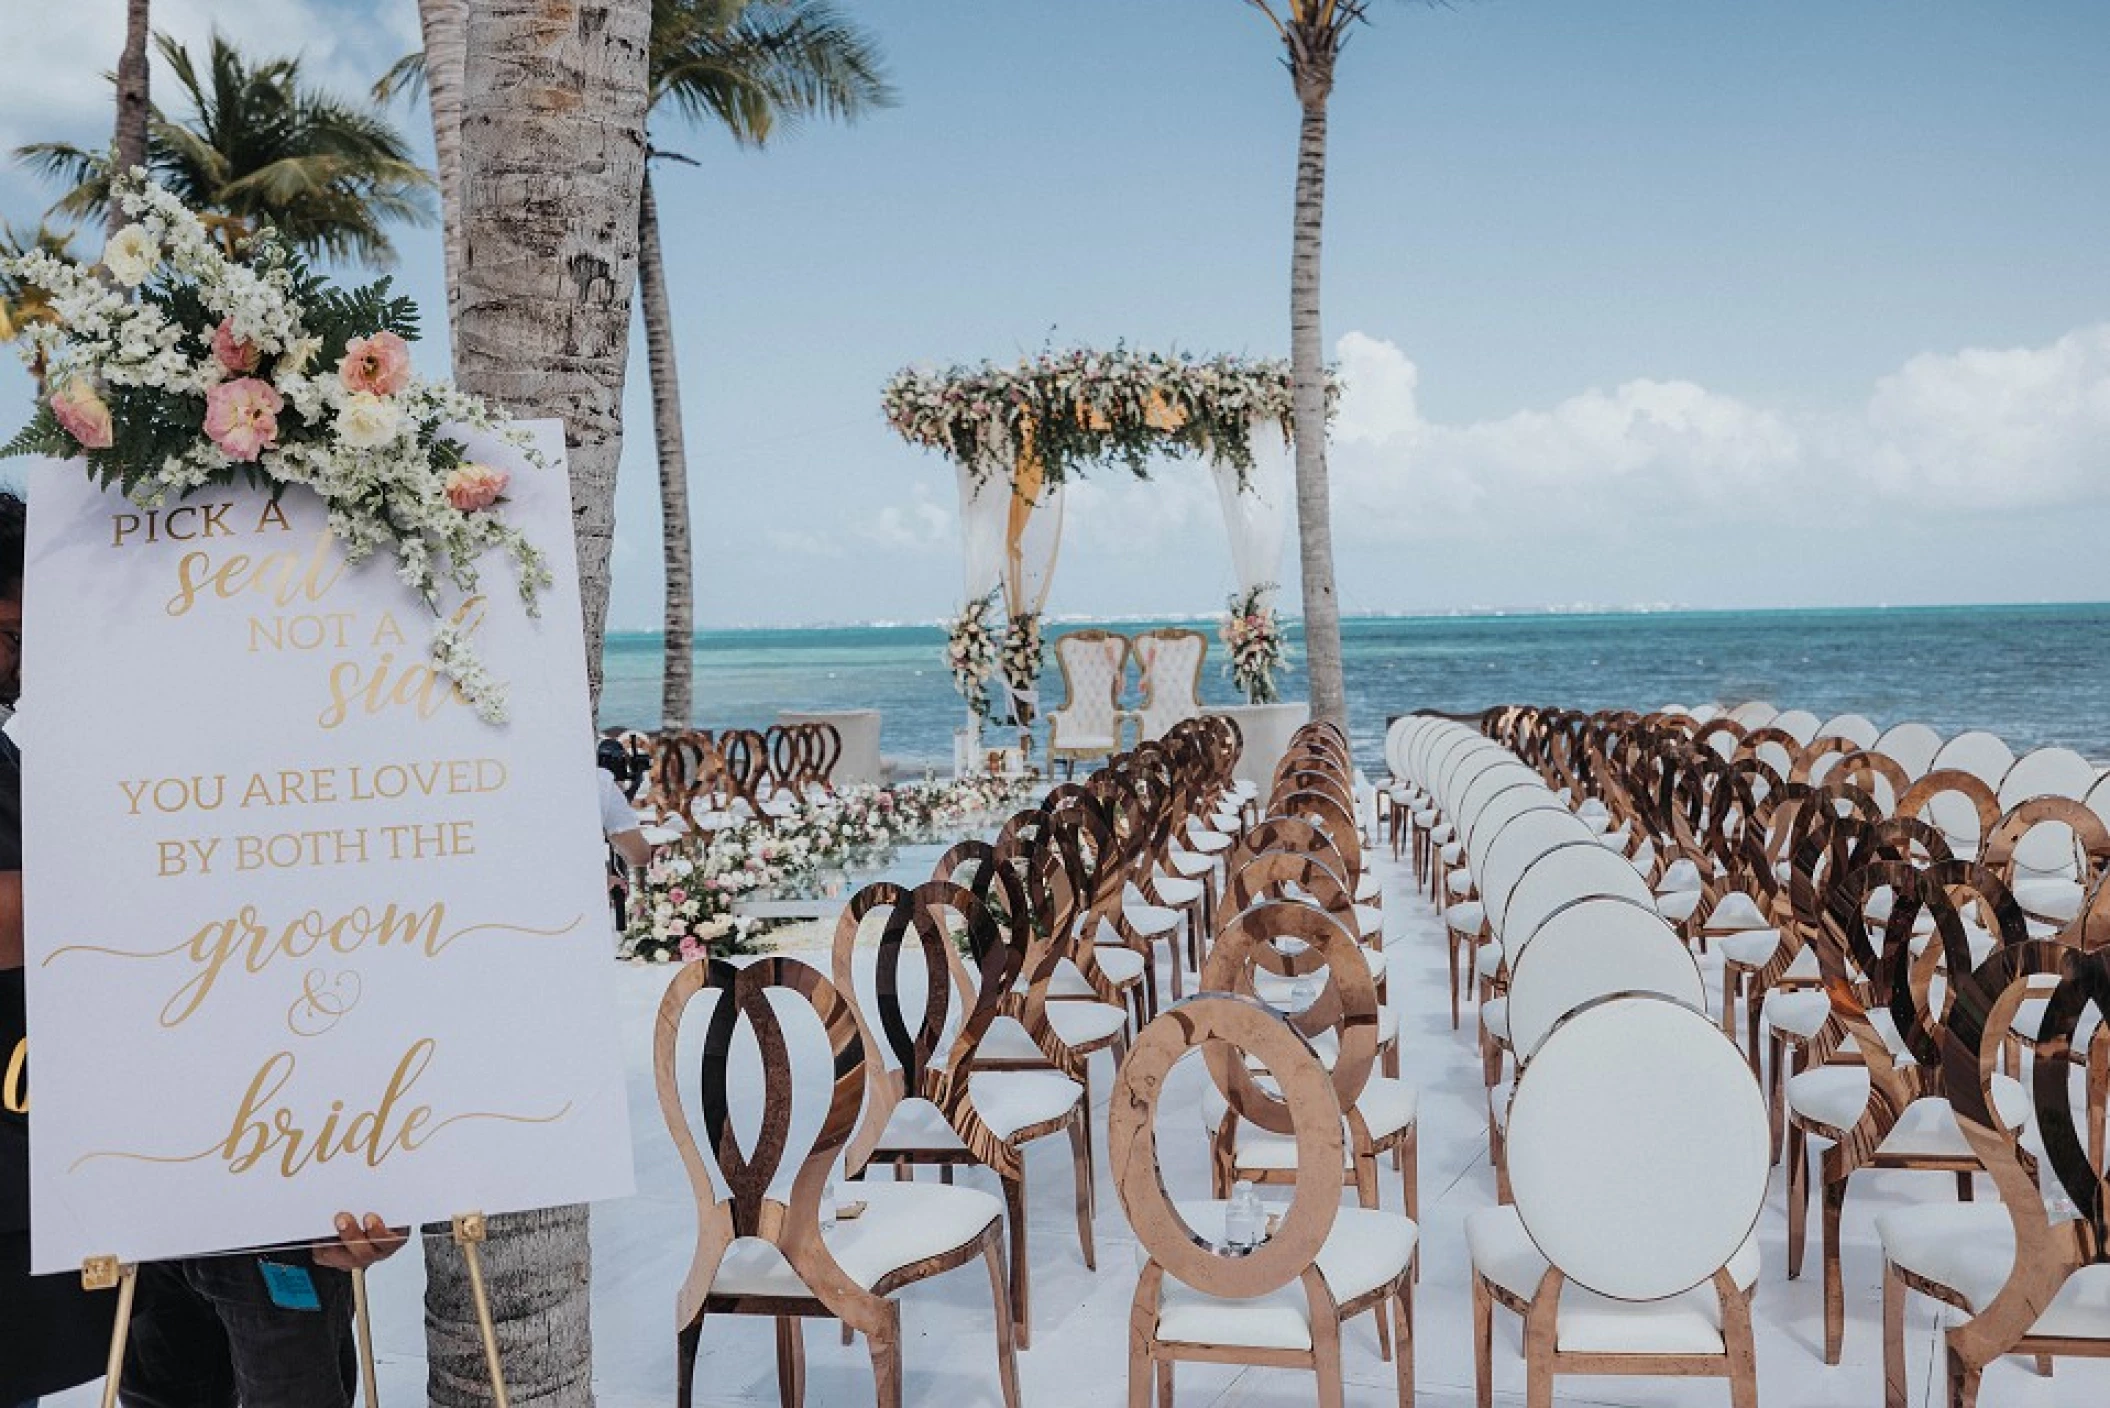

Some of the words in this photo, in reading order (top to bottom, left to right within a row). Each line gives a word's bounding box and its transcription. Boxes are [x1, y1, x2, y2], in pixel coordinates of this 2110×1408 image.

[111, 502, 235, 547] PICK
[255, 500, 292, 533] A
[247, 613, 356, 651] NOT
[370, 611, 406, 646] A
[119, 776, 225, 815] YOU
[239, 768, 338, 807] ARE
[349, 758, 507, 802] LOVED
[157, 838, 221, 877] BY
[235, 829, 371, 869] BOTH
[380, 821, 475, 859] THE
[42, 901, 584, 1028] groom
[287, 967, 362, 1037] &
